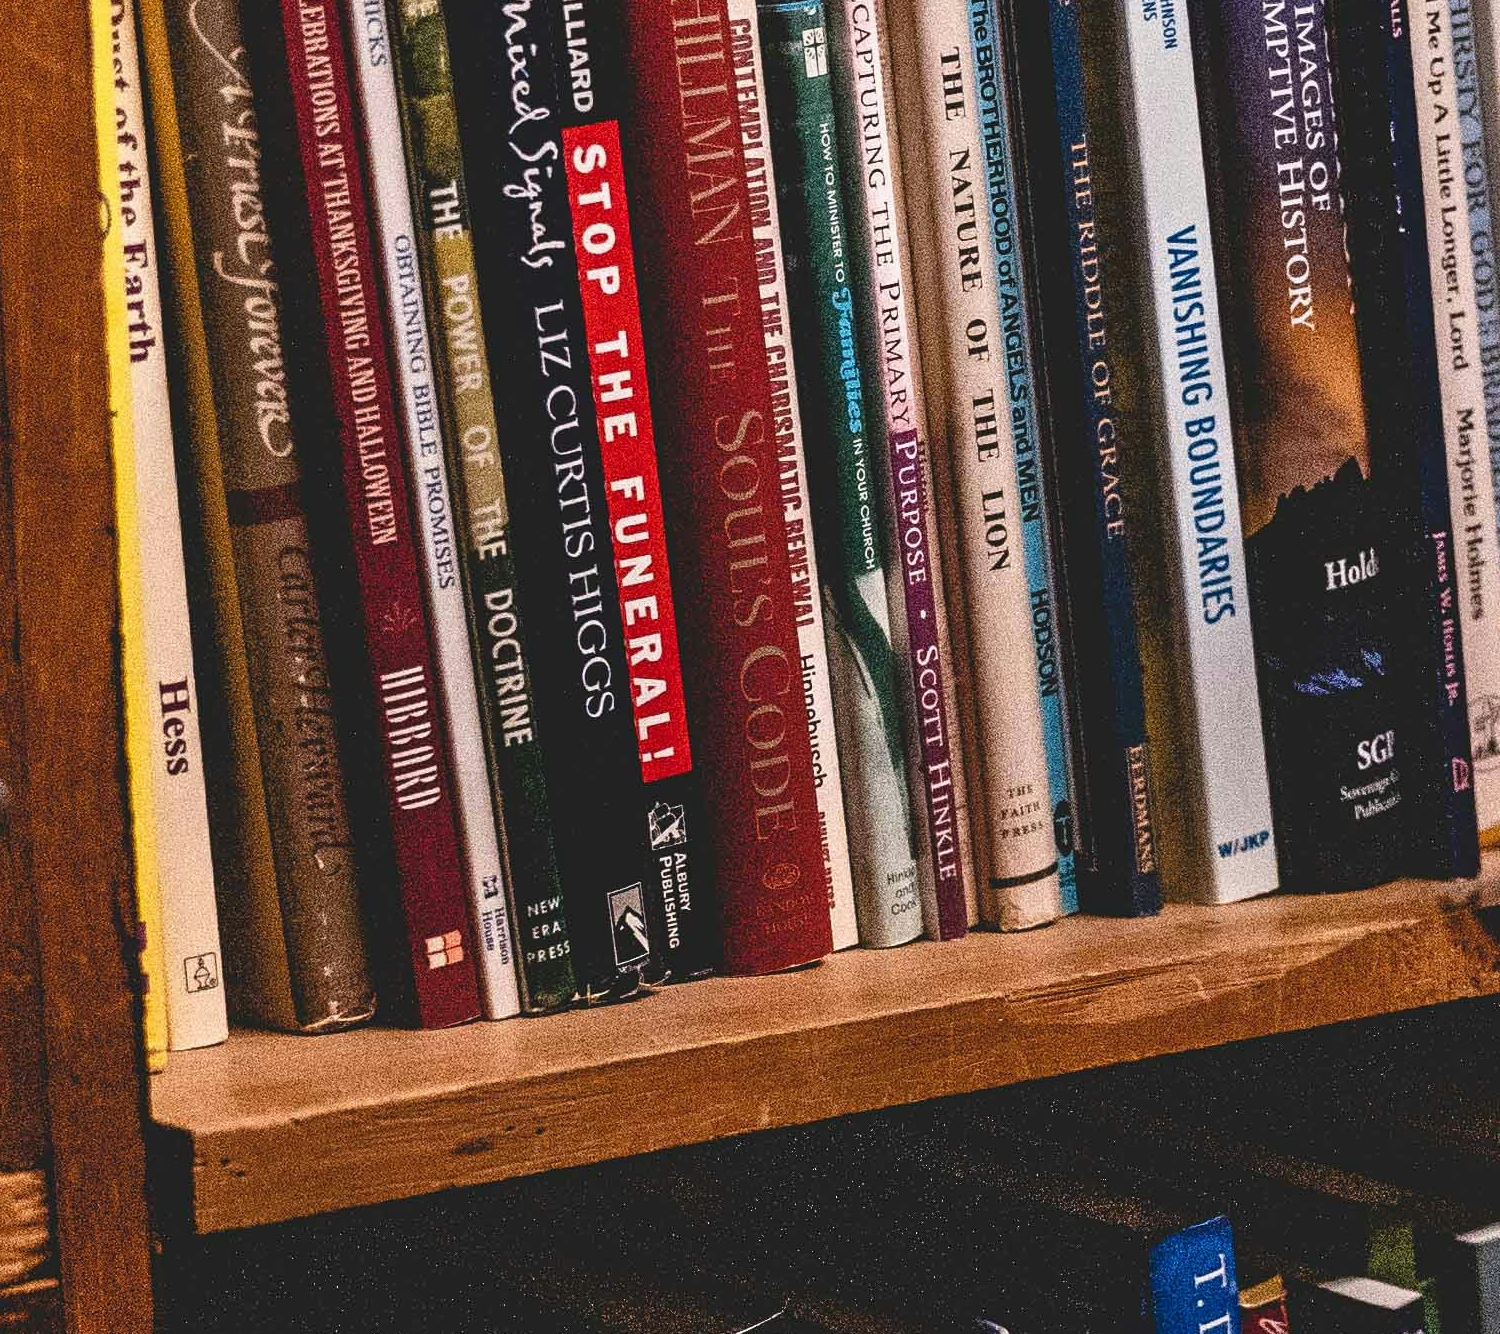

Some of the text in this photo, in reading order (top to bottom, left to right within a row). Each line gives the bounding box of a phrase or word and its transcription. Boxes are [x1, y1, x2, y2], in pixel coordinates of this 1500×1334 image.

[318, 142, 344, 168] AT
[1292, 3, 1331, 212] IMAGES OF
[323, 172, 370, 350] THANKSGIVING
[503, 141, 566, 270] Signals
[1274, 161, 1315, 331] HISTORY
[346, 357, 378, 404] AND
[940, 47, 1010, 572] THE NATURE OF THE LION
[355, 408, 398, 545] HALLOWEEN
[392, 234, 457, 590] OBTAINING BIBLE PROMISES
[428, 181, 533, 747] THE POWER OF THE DOCTRINE
[573, 143, 675, 763] STOP THE FUNERAL!
[1166, 225, 1234, 625] VANISHING BOUNDARIES
[534, 303, 614, 718] LIZ CURTIS HIGGS
[699, 277, 796, 842] THE SOUL'S CODE
[158, 678, 191, 776] Hess
[380, 665, 441, 811] HIBBARD
[659, 856, 682, 948] PUBLISHING
[674, 852, 690, 911] ALBURY
